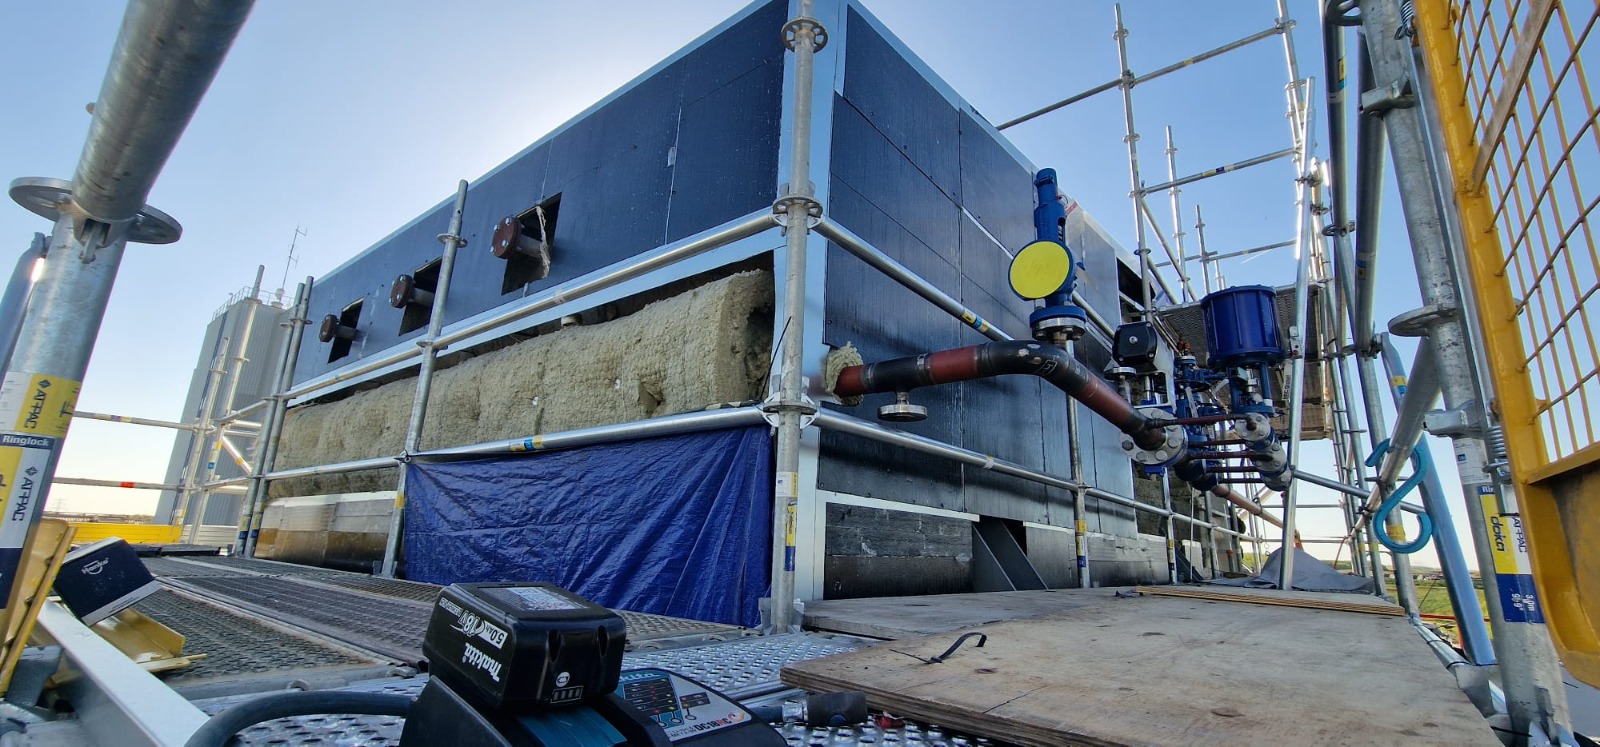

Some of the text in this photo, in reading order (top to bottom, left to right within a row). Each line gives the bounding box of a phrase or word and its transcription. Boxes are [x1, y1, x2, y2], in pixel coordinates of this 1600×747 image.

[24, 389, 47, 430] AT-PAC
[2, 434, 50, 448] Ringlock
[12, 477, 34, 522] AT-PAC
[1490, 515, 1506, 552] doka
